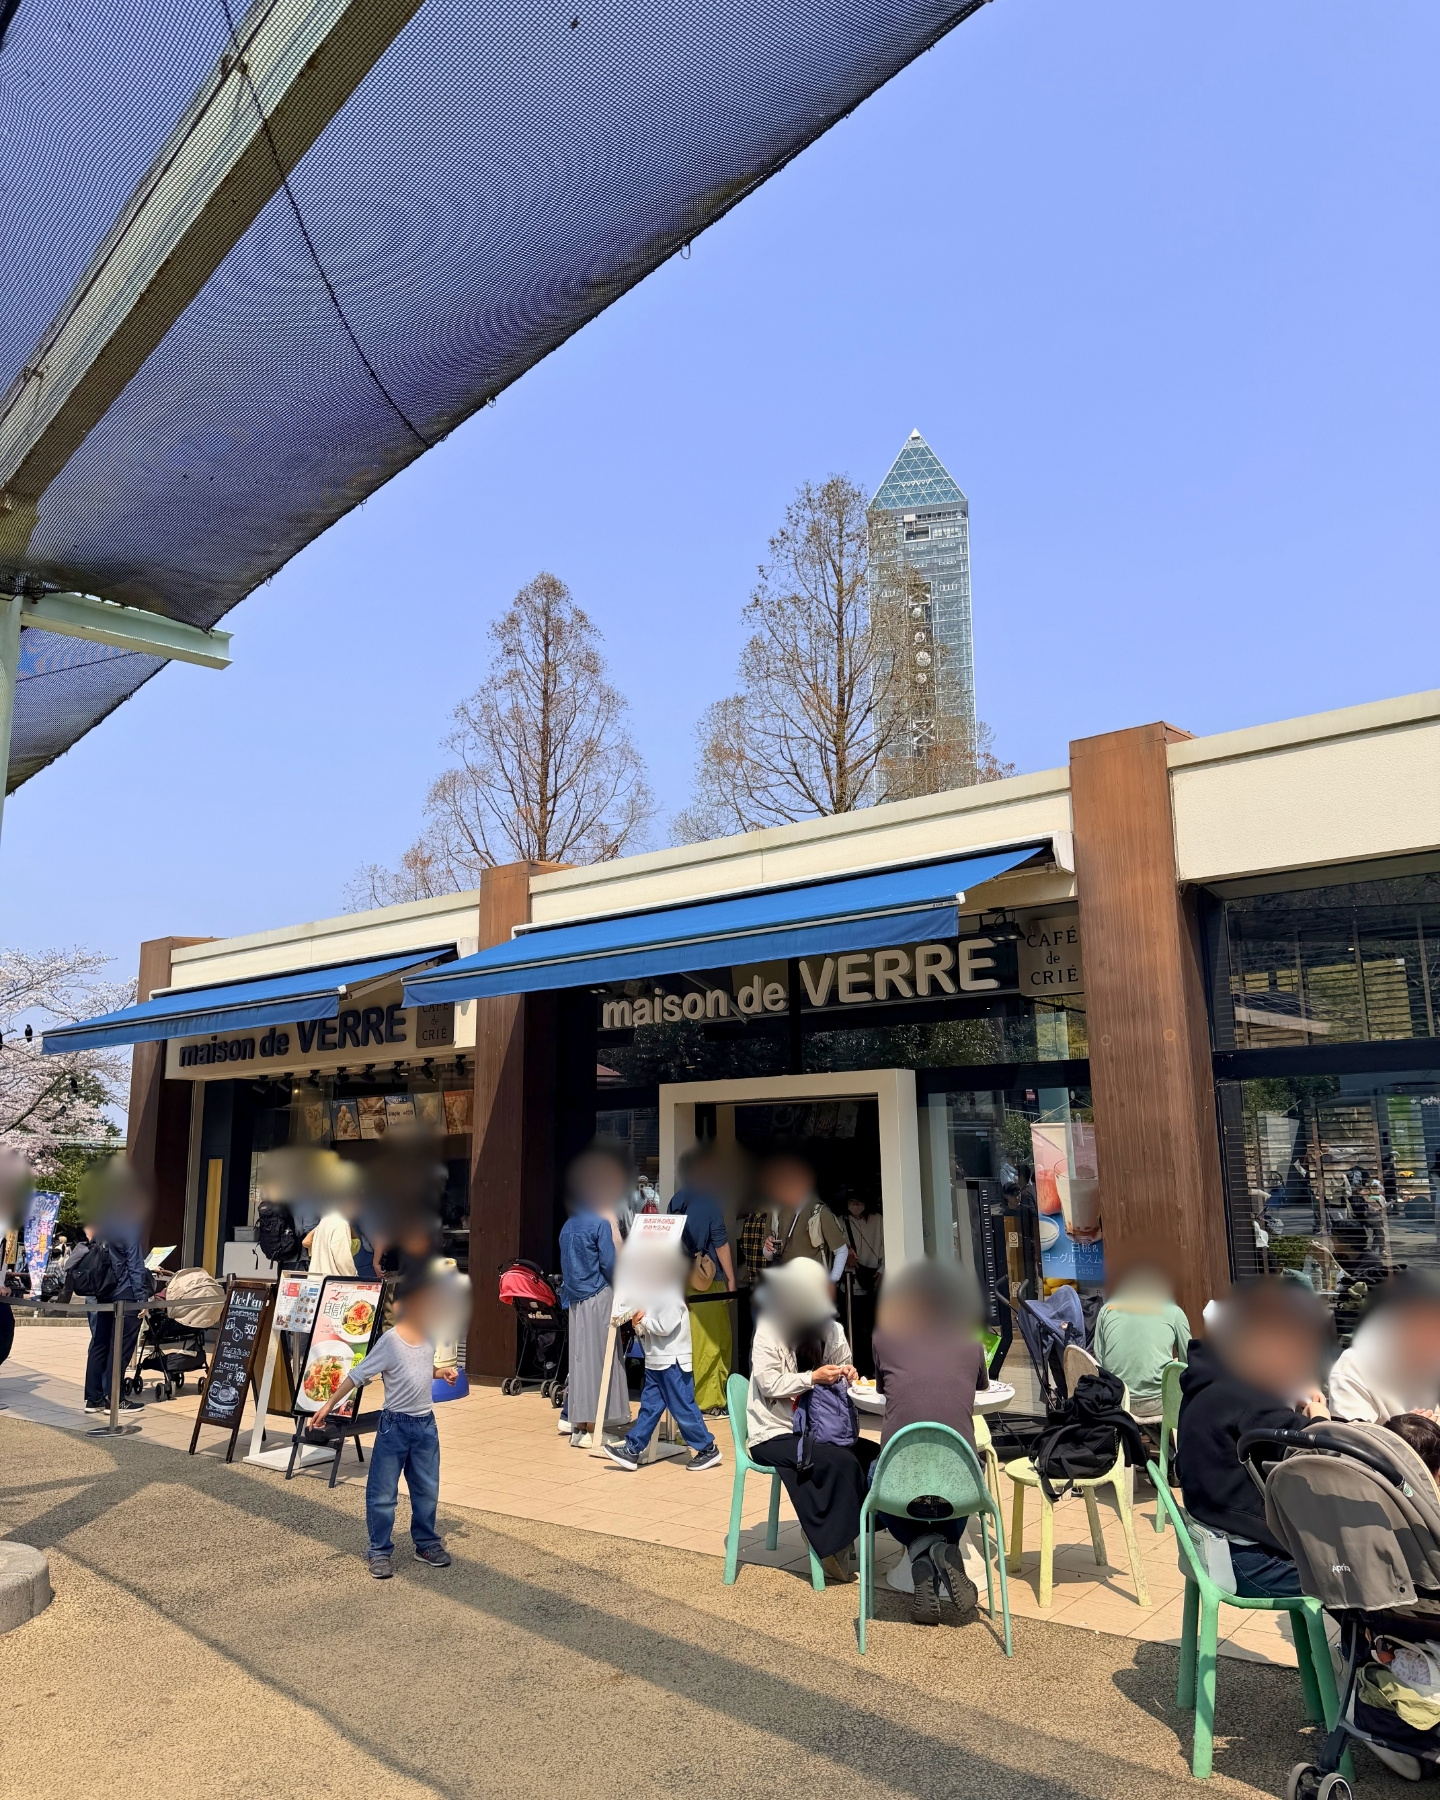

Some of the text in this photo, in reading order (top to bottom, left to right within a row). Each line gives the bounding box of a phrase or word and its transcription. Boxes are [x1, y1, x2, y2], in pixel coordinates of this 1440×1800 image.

[1026, 926, 1079, 948] CAFÉ
[1046, 953, 1062, 965] de
[602, 938, 1000, 1028] maison de VERRE
[1030, 967, 1080, 985] CRIÉ
[430, 1014, 441, 1025] de
[179, 1003, 408, 1067] maison de VERRE
[422, 1026, 448, 1041] CRIÉ
[1071, 1242, 1099, 1252] 白桃&
